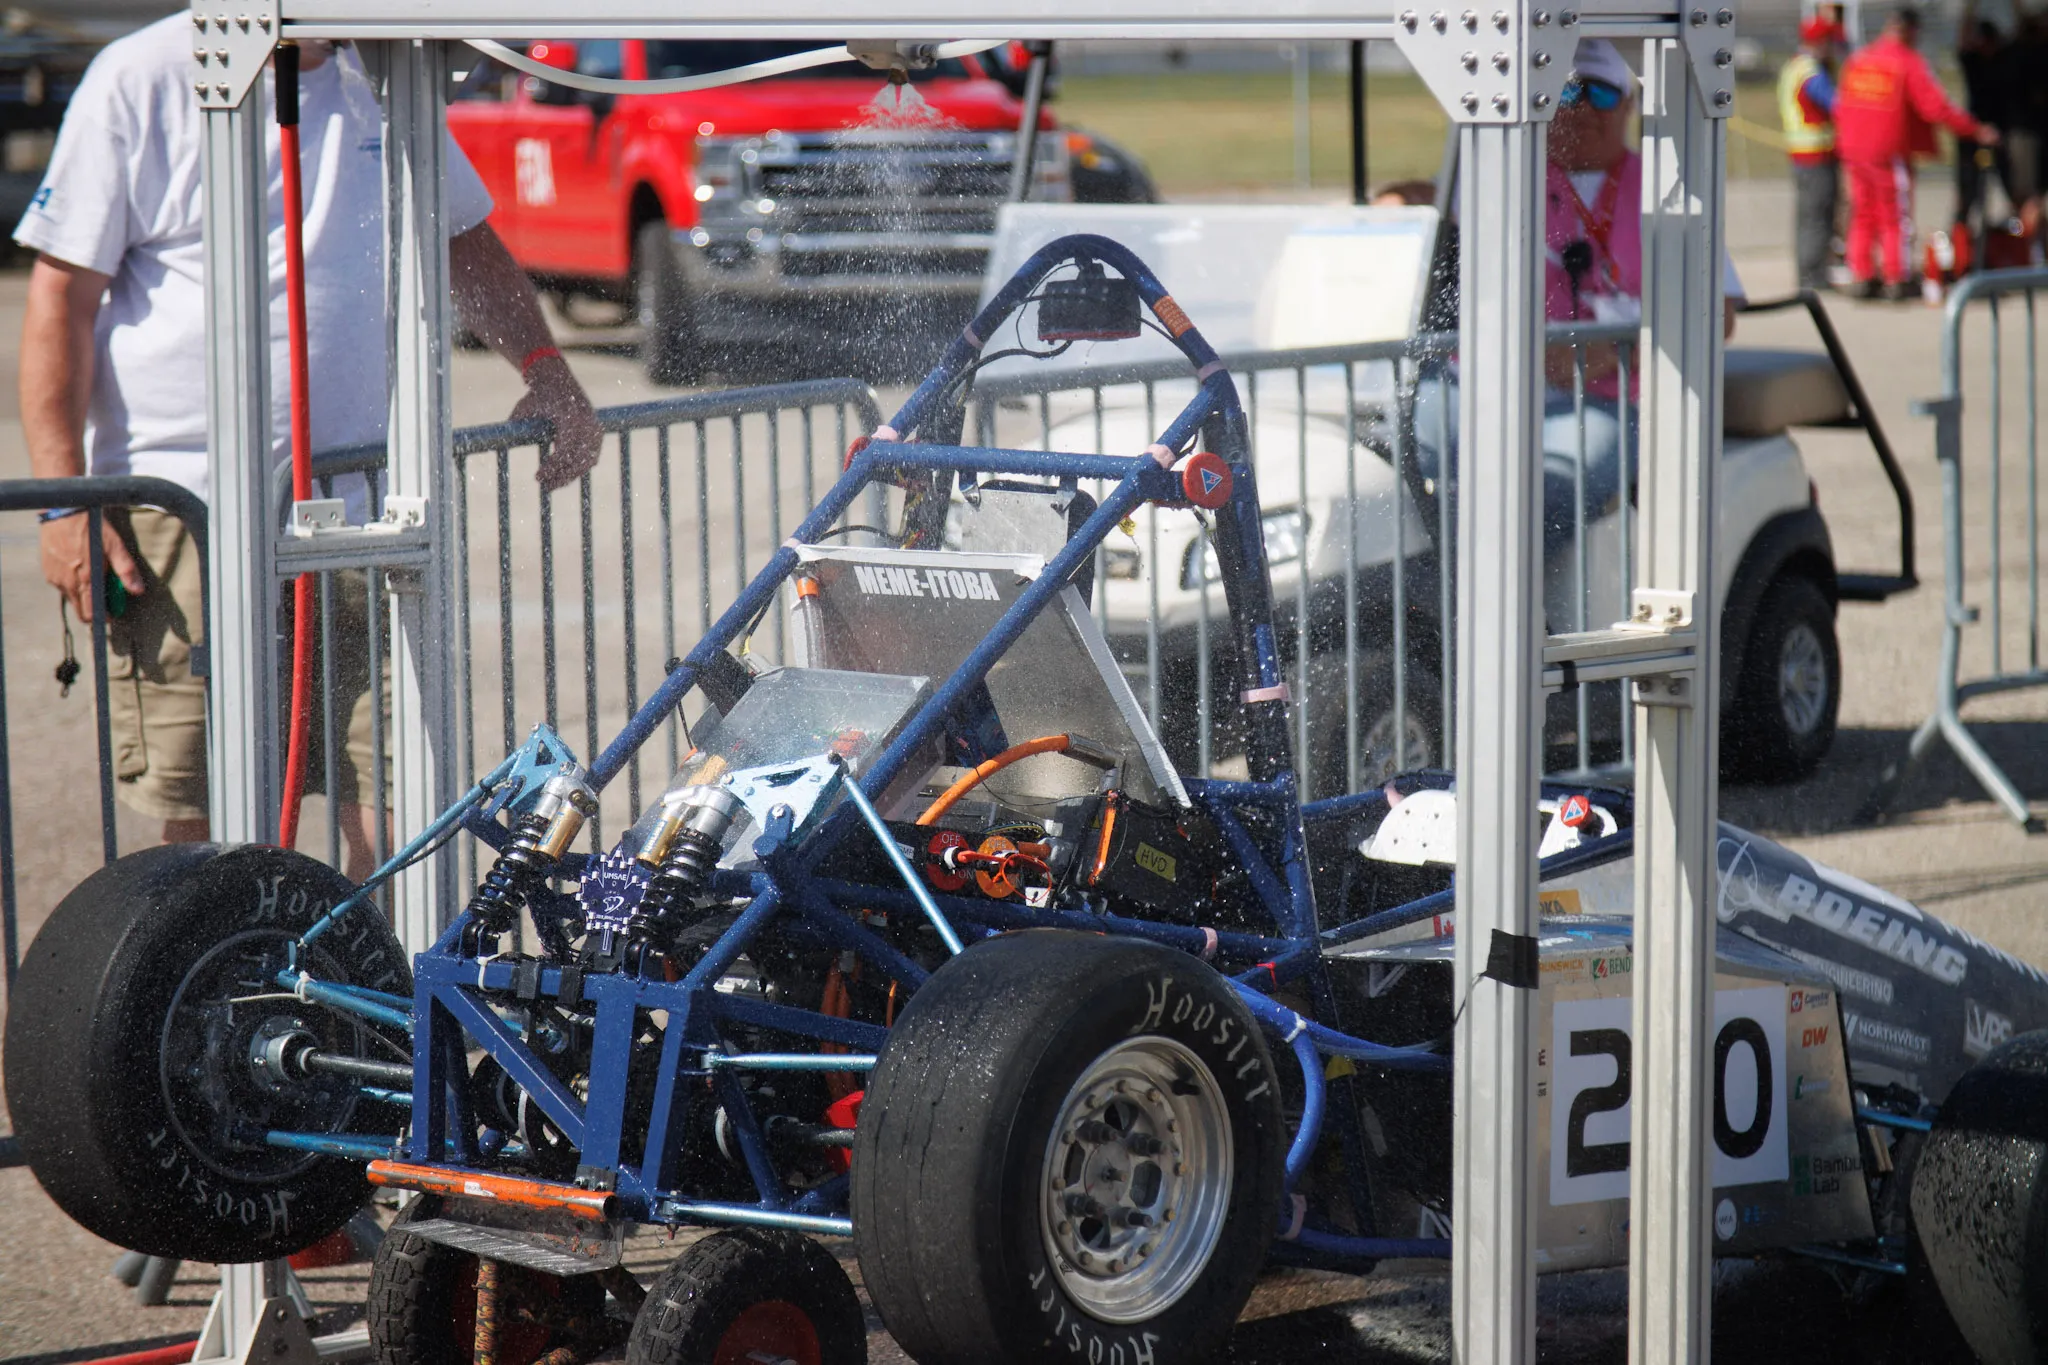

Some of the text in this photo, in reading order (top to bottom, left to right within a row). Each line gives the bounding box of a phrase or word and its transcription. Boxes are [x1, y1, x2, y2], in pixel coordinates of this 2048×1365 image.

[853, 565, 1001, 601] MEME-ITOBA
[941, 833, 961, 845] OFF
[958, 868, 975, 880] ON
[1777, 873, 1968, 986] BOEING
[1802, 1026, 1829, 1049] DW
[1858, 1019, 1928, 1051] NORTHWEST
[1813, 1176, 1840, 1195] Lab
